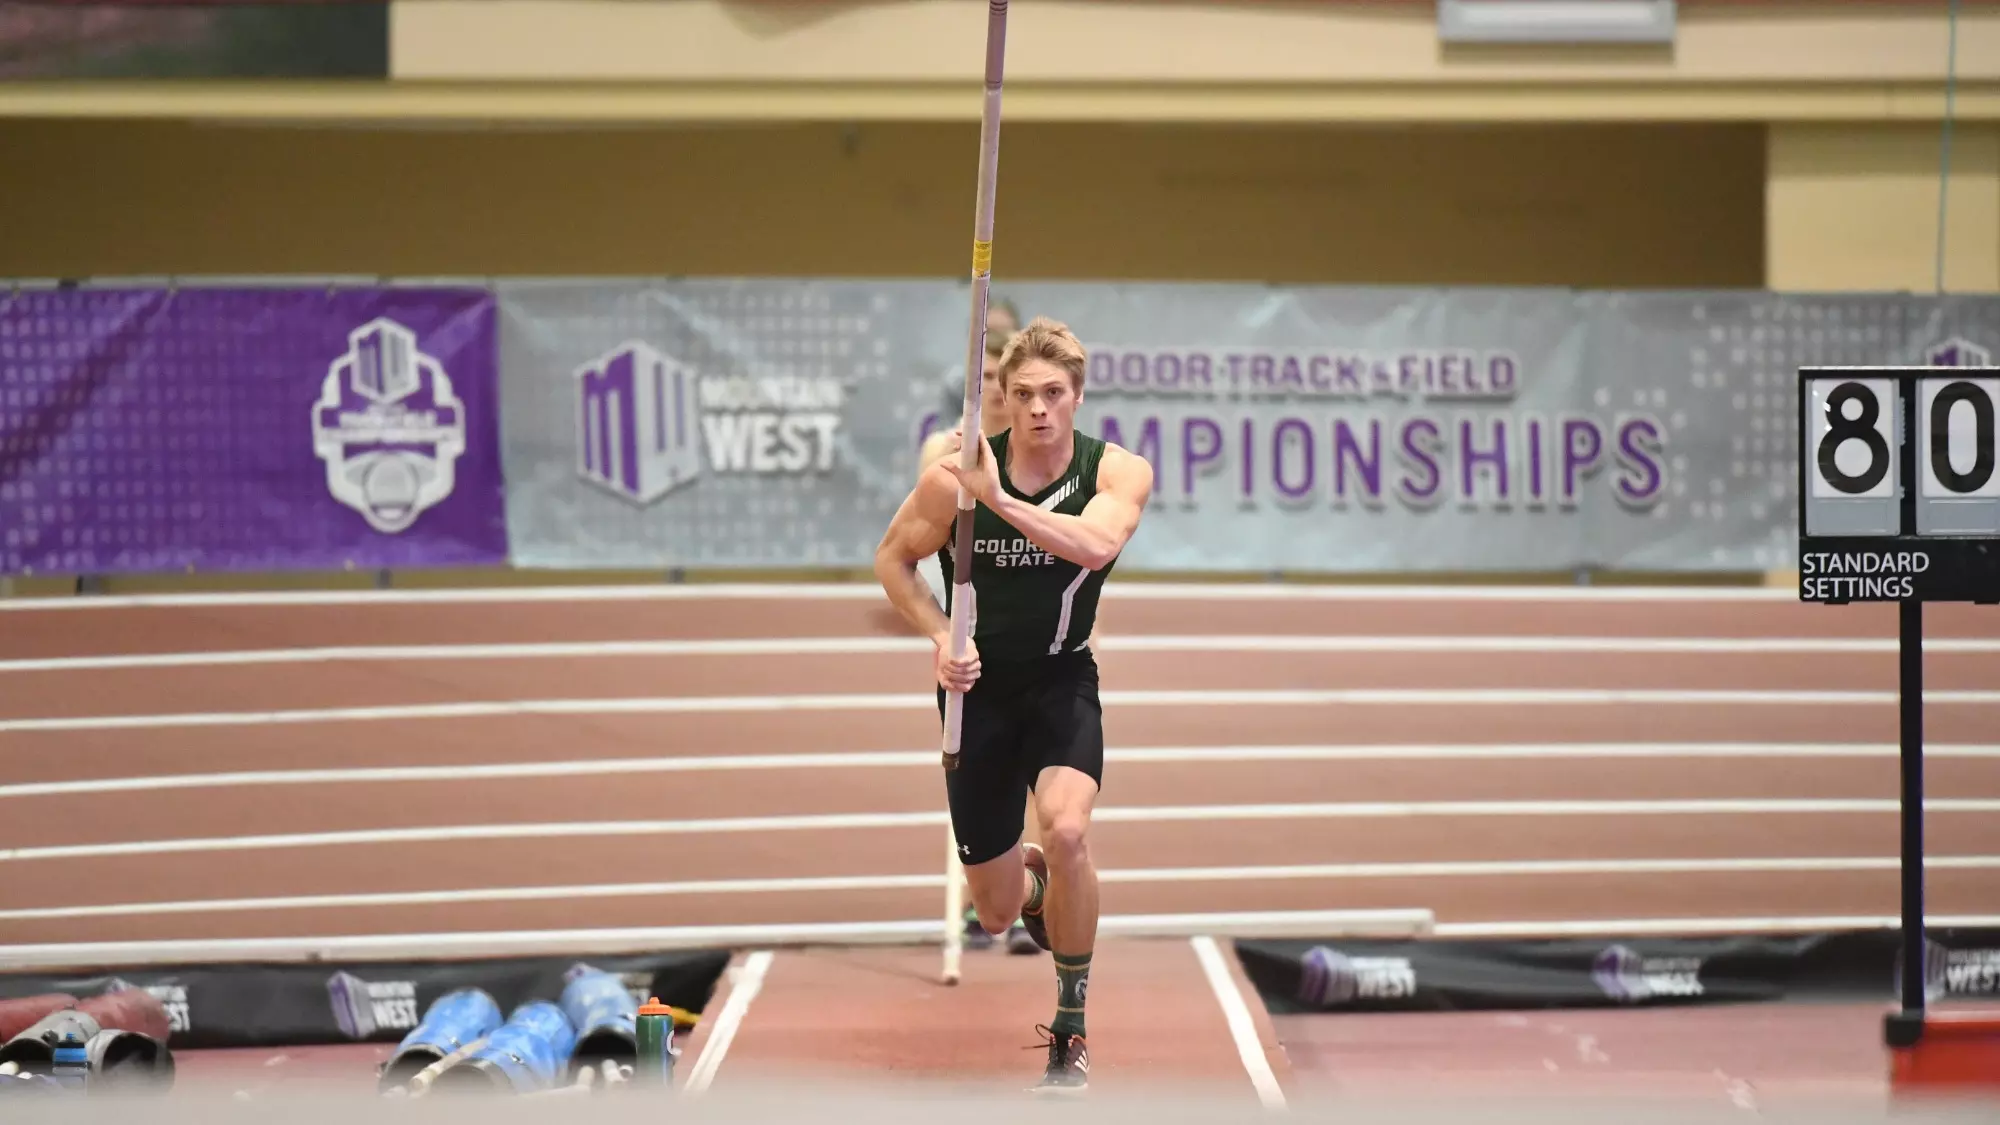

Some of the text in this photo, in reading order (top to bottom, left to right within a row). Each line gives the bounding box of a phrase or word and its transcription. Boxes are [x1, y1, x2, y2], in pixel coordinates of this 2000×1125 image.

[1089, 352, 1212, 388] DOOR
[1225, 354, 1361, 388] TRACK
[1398, 355, 1514, 390] FIELD
[702, 413, 840, 472] WEST
[918, 411, 1661, 498] MPIONSHIPS
[973, 538, 1044, 554] COLOR
[995, 553, 1055, 567] STATE
[1802, 552, 1930, 573] STANDARD
[1802, 576, 1914, 598] SETTINGS
[371, 1000, 419, 1028] WEST
